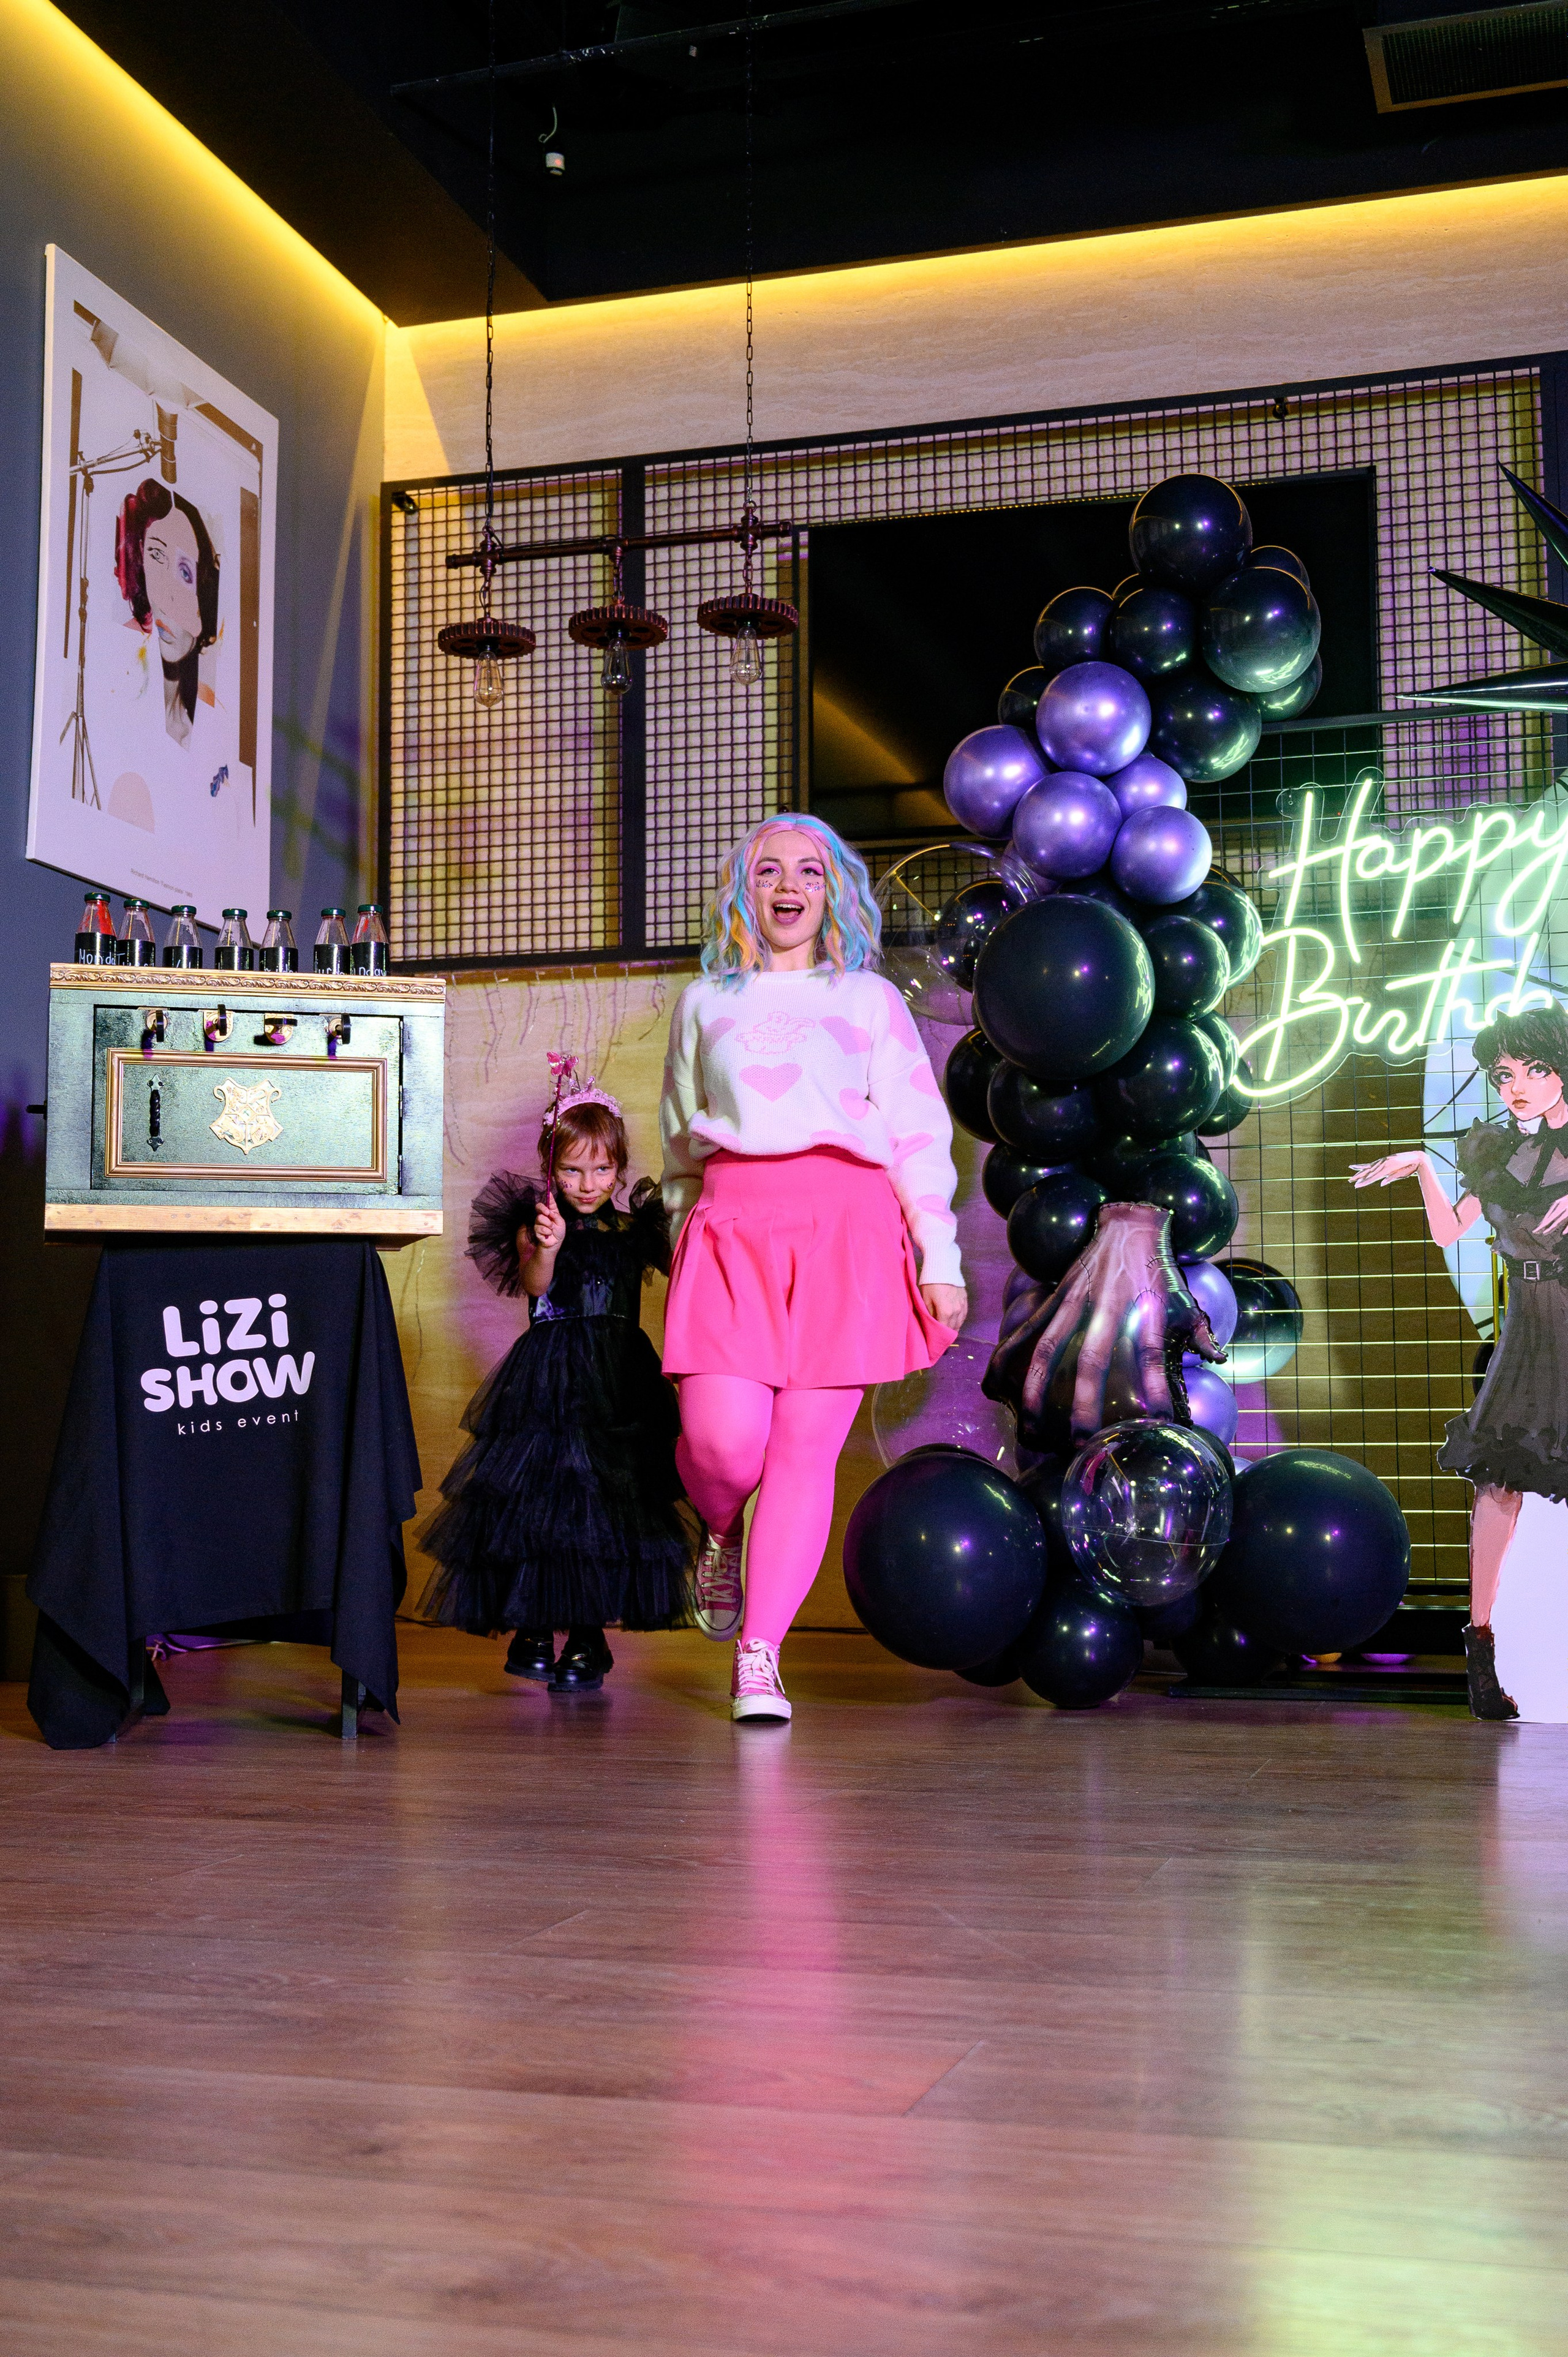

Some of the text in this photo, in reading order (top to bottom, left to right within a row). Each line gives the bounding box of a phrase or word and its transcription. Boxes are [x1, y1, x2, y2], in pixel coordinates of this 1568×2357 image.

[1268, 777, 1568, 963] Happy
[79, 948, 115, 966] Monda
[140, 1351, 315, 1412] SHOW
[177, 1409, 299, 1436] kids event
